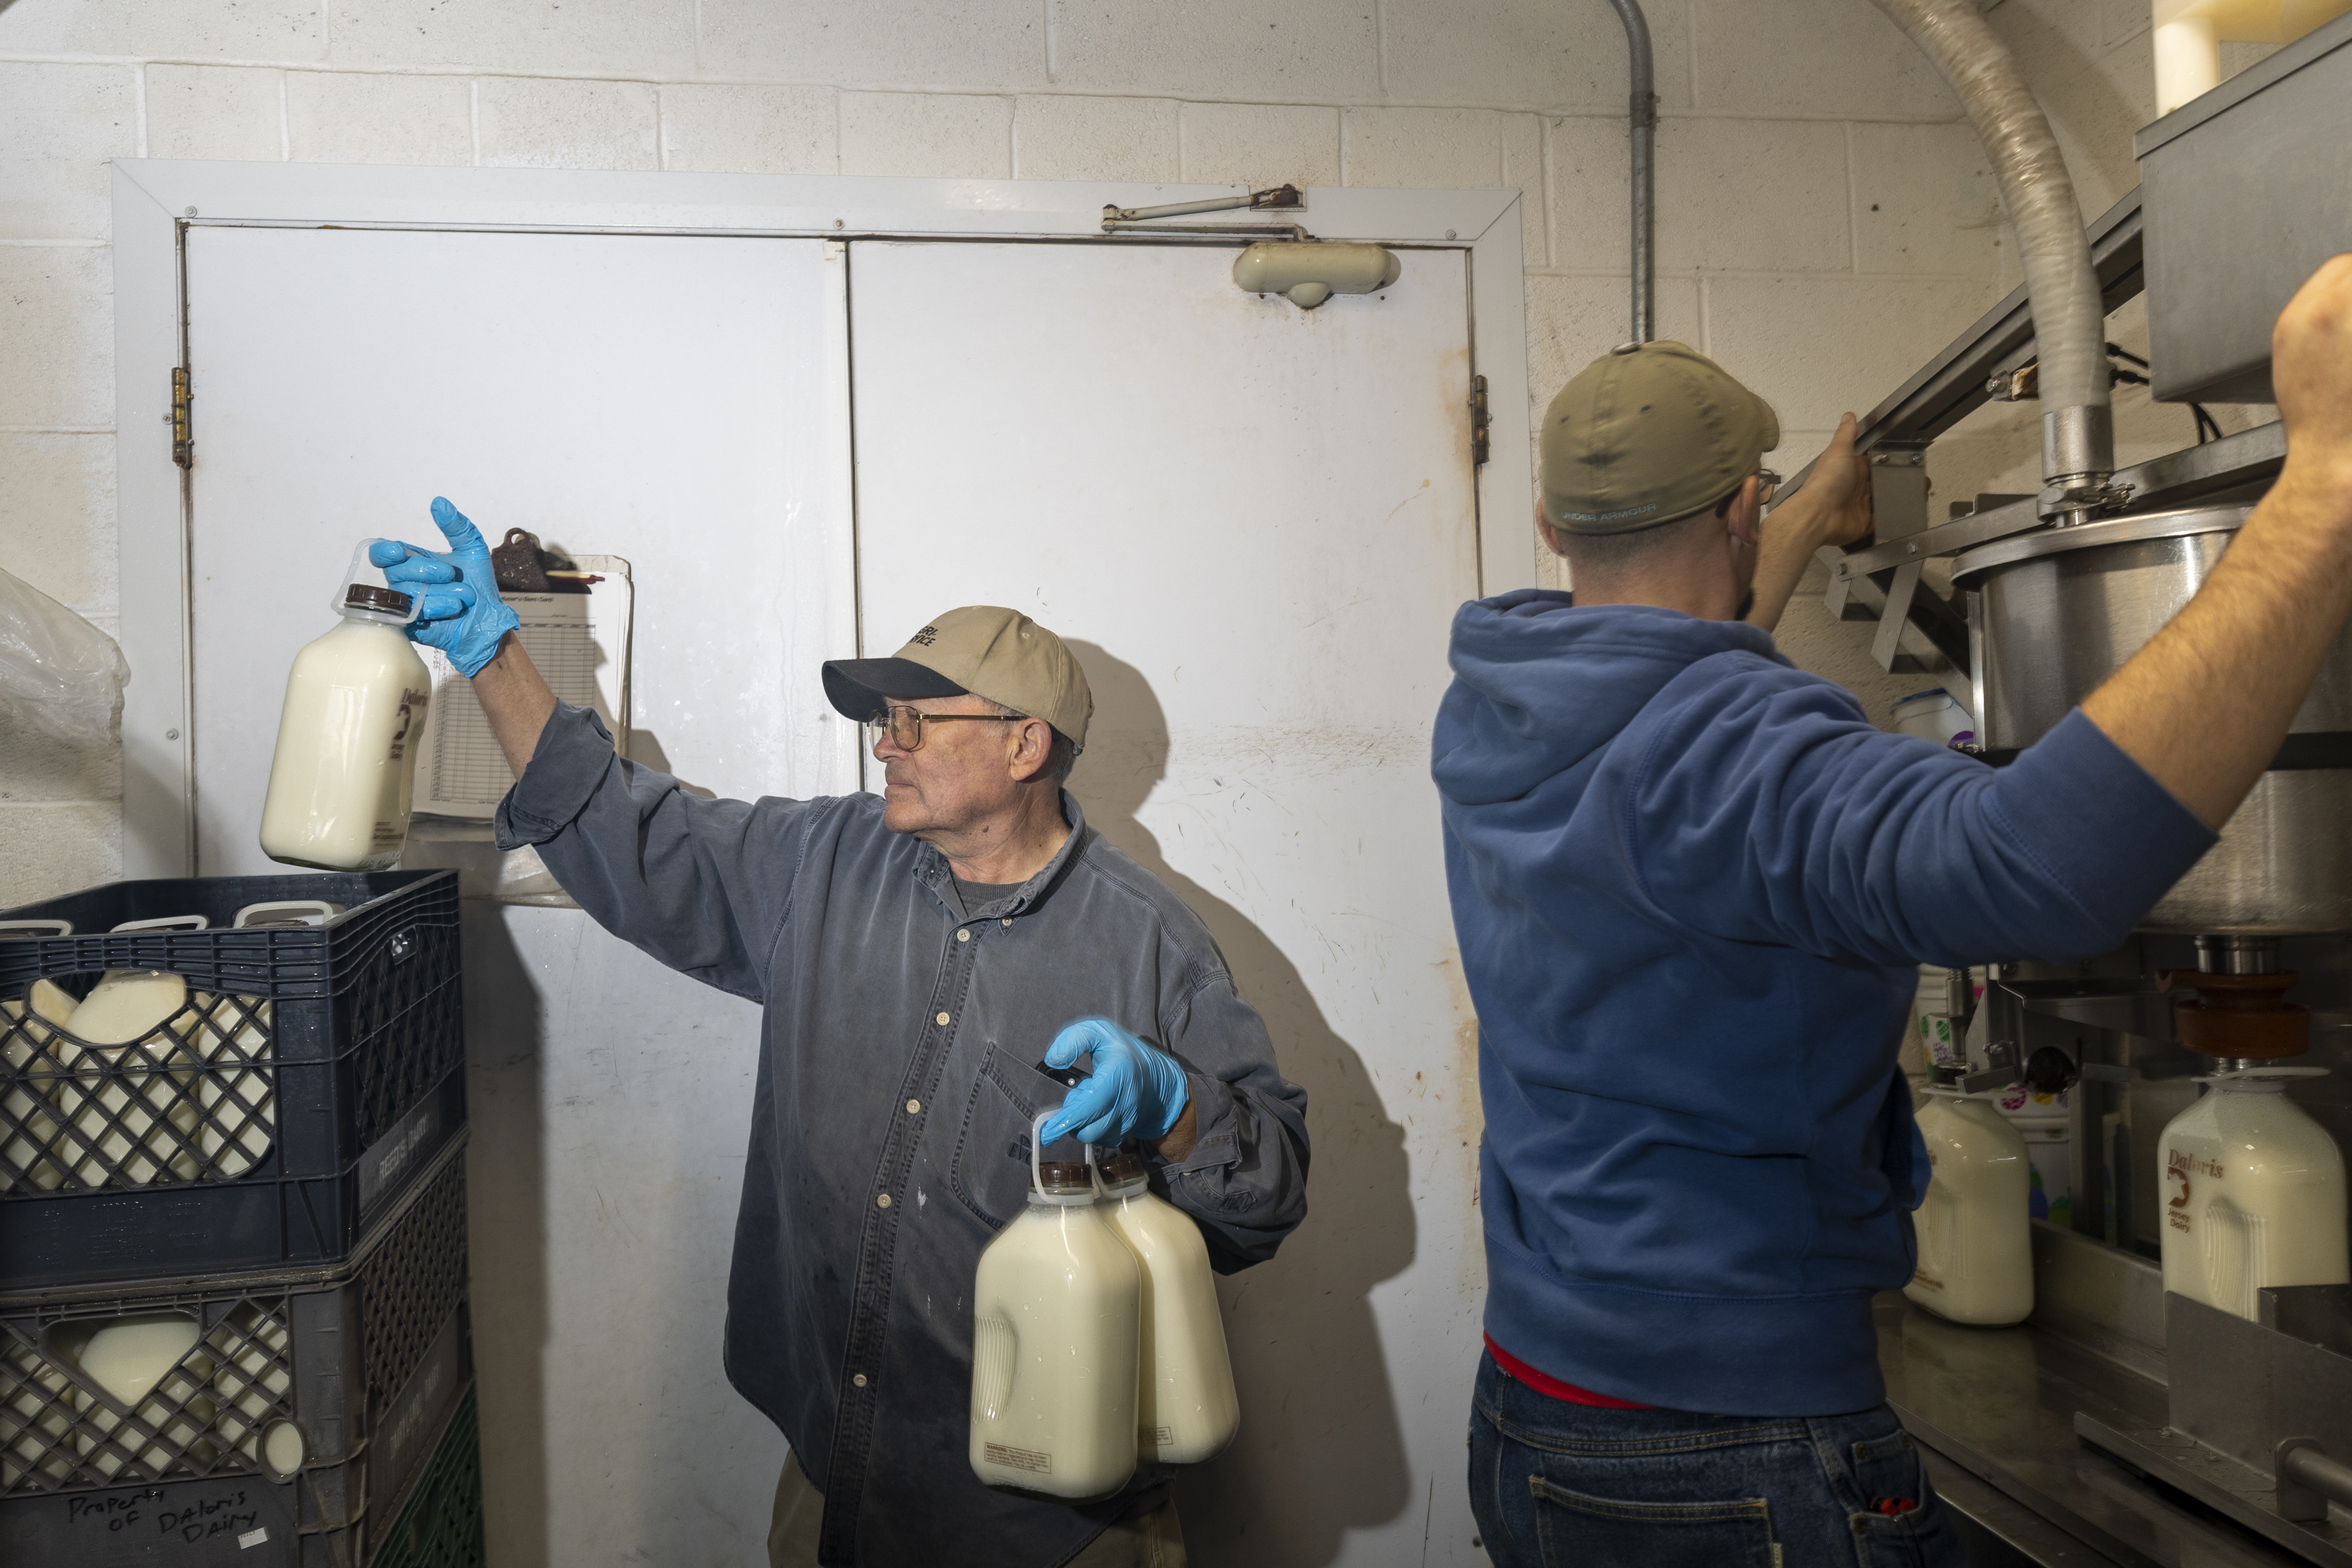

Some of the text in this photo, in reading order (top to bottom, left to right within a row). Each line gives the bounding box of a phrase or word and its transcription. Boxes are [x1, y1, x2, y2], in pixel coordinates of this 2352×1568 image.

[1562, 503, 1657, 522] UNDER ARMOUR
[2167, 1208, 2190, 1223] Jersey
[2170, 1218, 2190, 1233] Dairy
